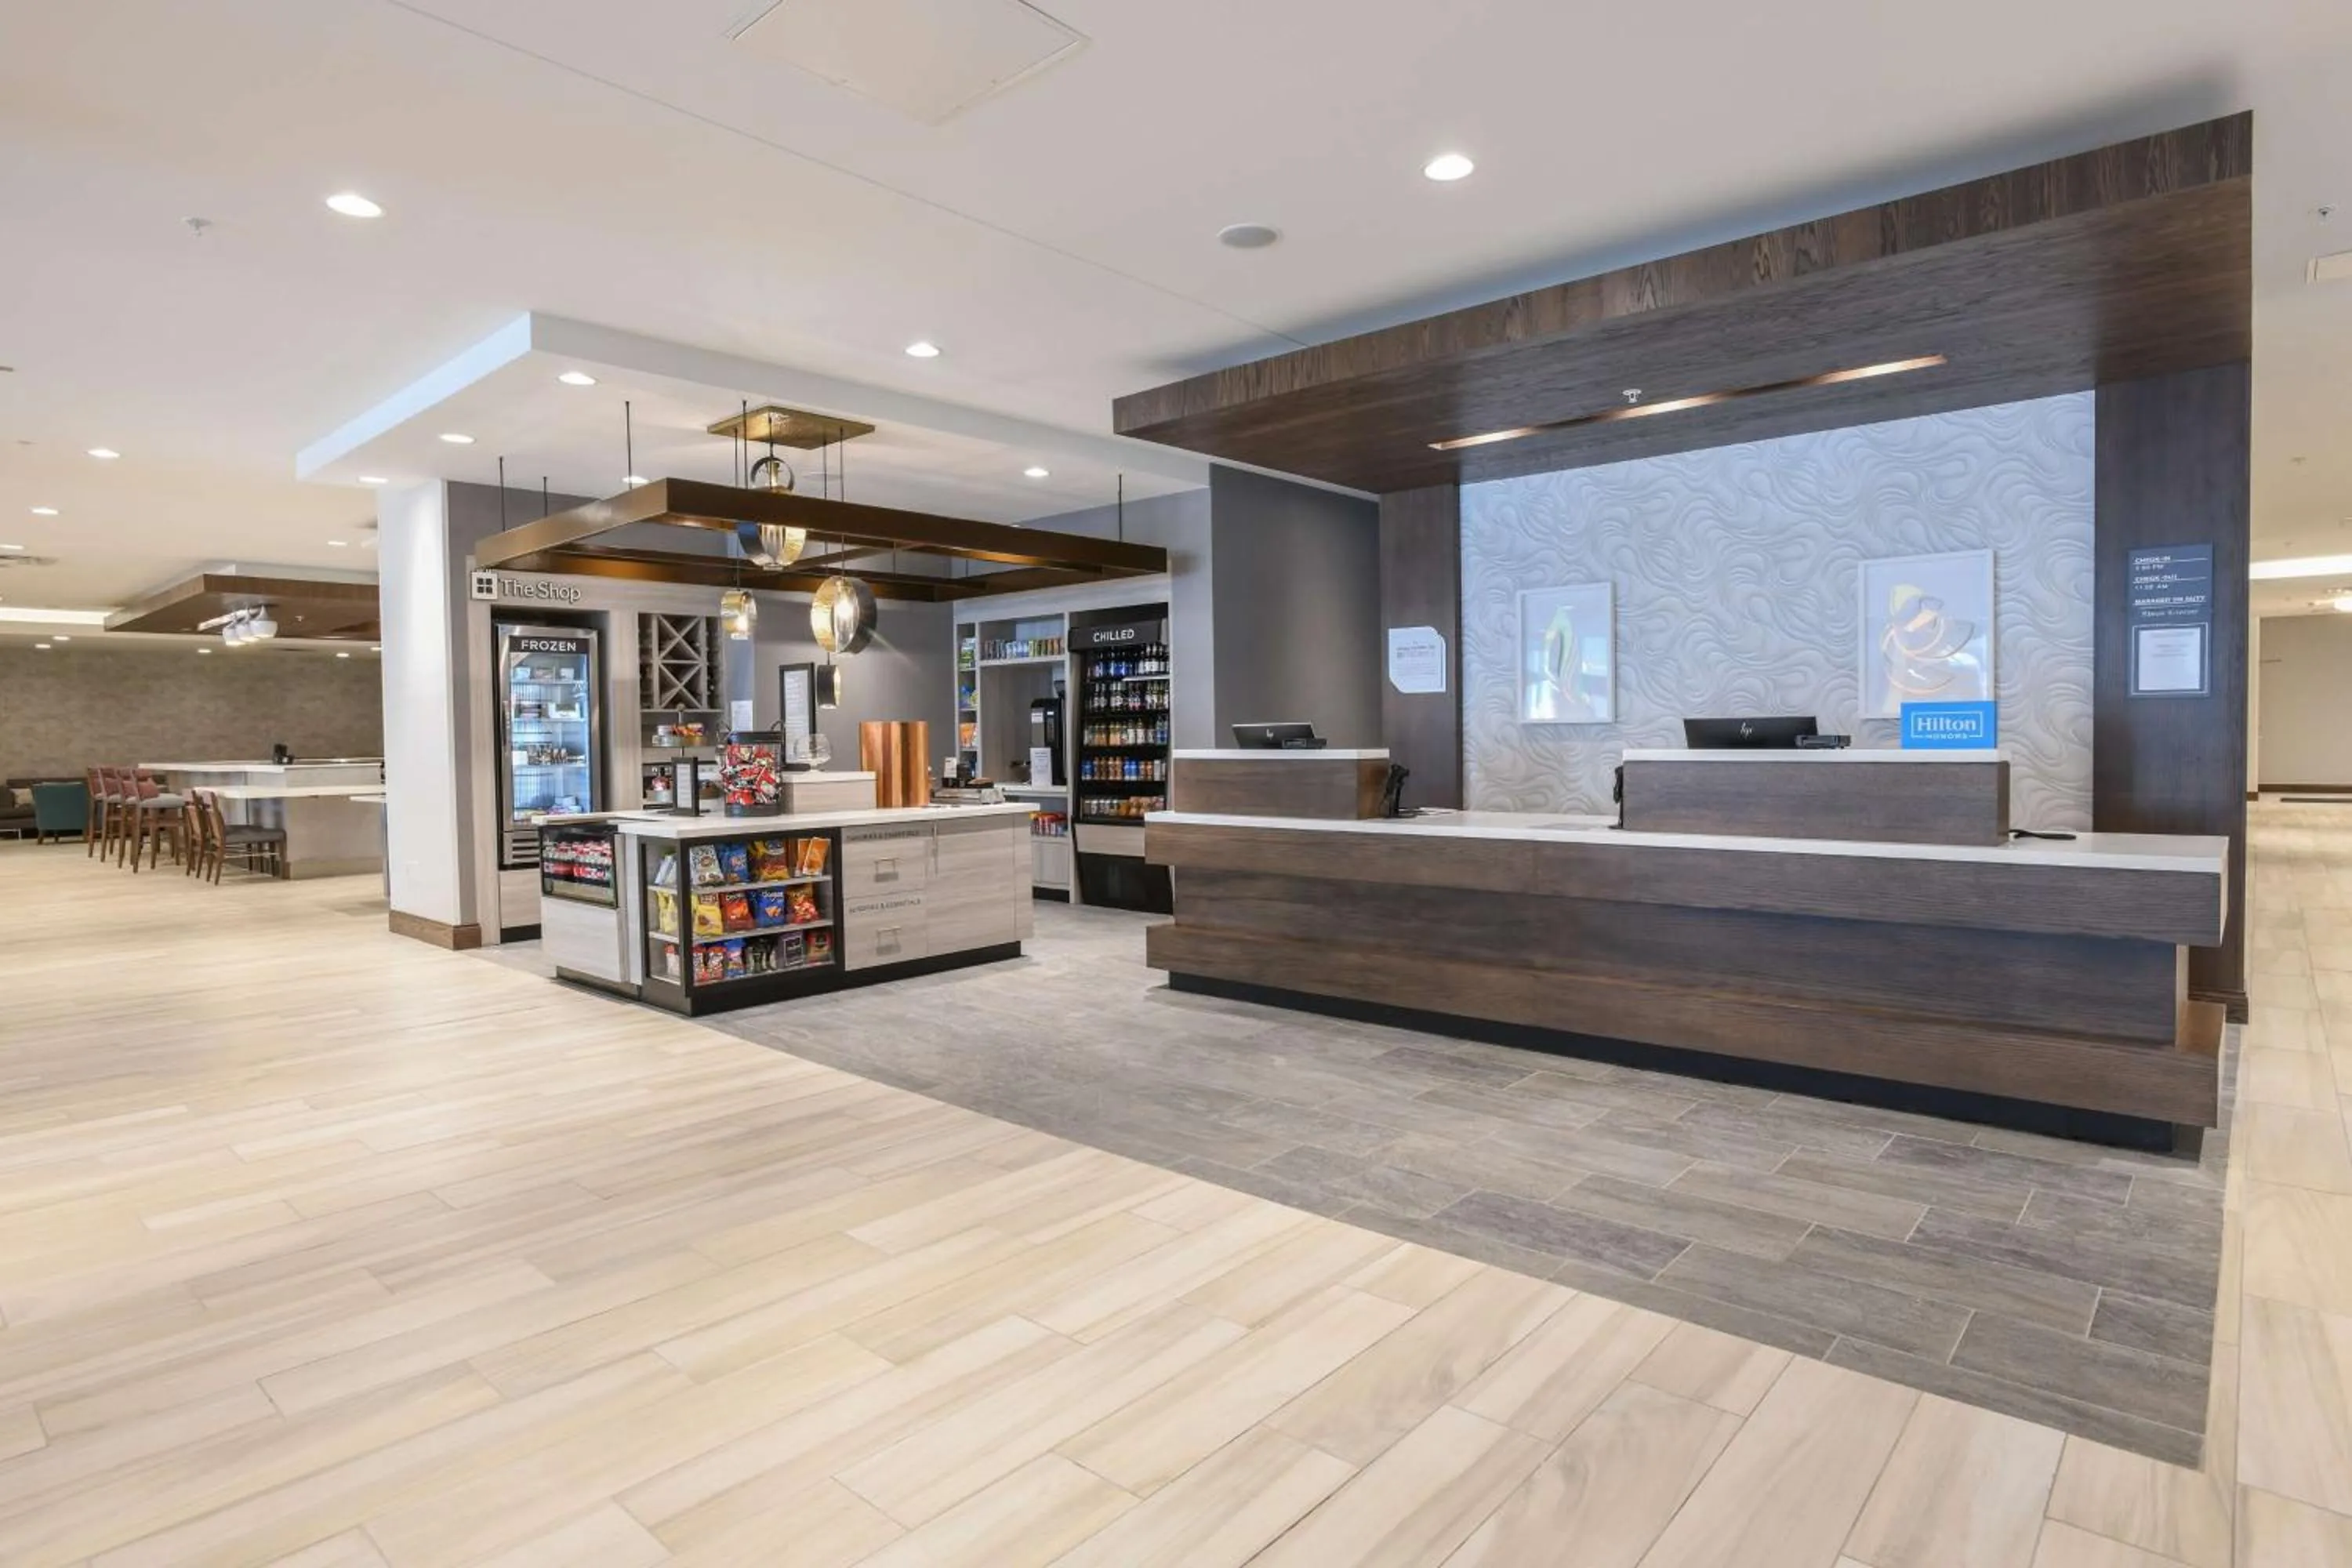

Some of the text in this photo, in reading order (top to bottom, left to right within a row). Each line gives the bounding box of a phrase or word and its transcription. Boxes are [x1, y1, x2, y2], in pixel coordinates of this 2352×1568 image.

[503, 579, 582, 603] The Shop
[1093, 629, 1135, 643] CHILLED
[521, 639, 577, 652] FROZEN
[1917, 717, 1976, 732] Hilton
